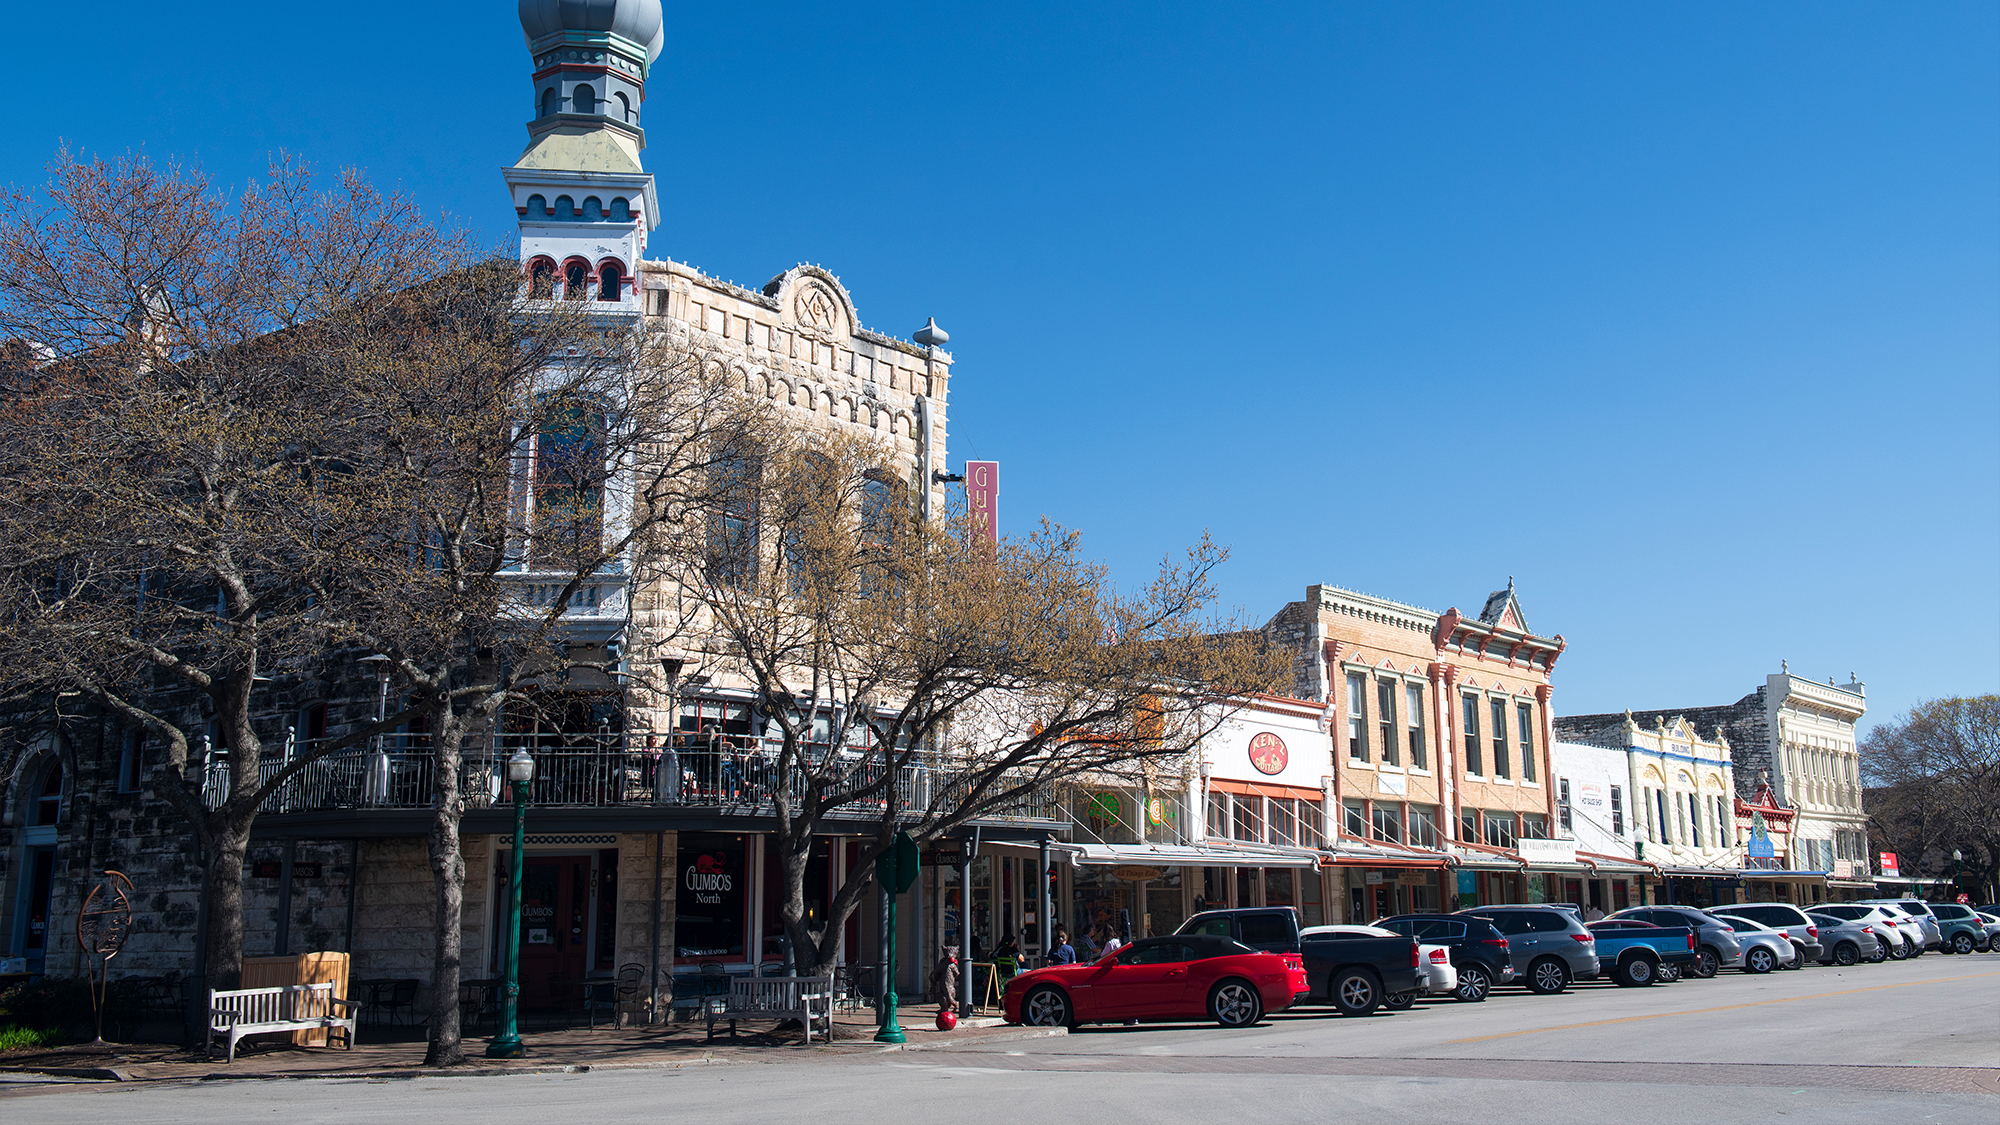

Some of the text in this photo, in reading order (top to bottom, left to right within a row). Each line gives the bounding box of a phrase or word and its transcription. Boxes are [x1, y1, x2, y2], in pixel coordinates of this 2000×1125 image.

[1671, 743, 1690, 755] BUILDING
[292, 867, 315, 877] MBO'S
[1126, 870, 1144, 878] Things
[590, 870, 598, 897] 701
[685, 865, 732, 892] GUMBO'S
[695, 892, 721, 904] North
[521, 903, 554, 917] GUMBO'S
